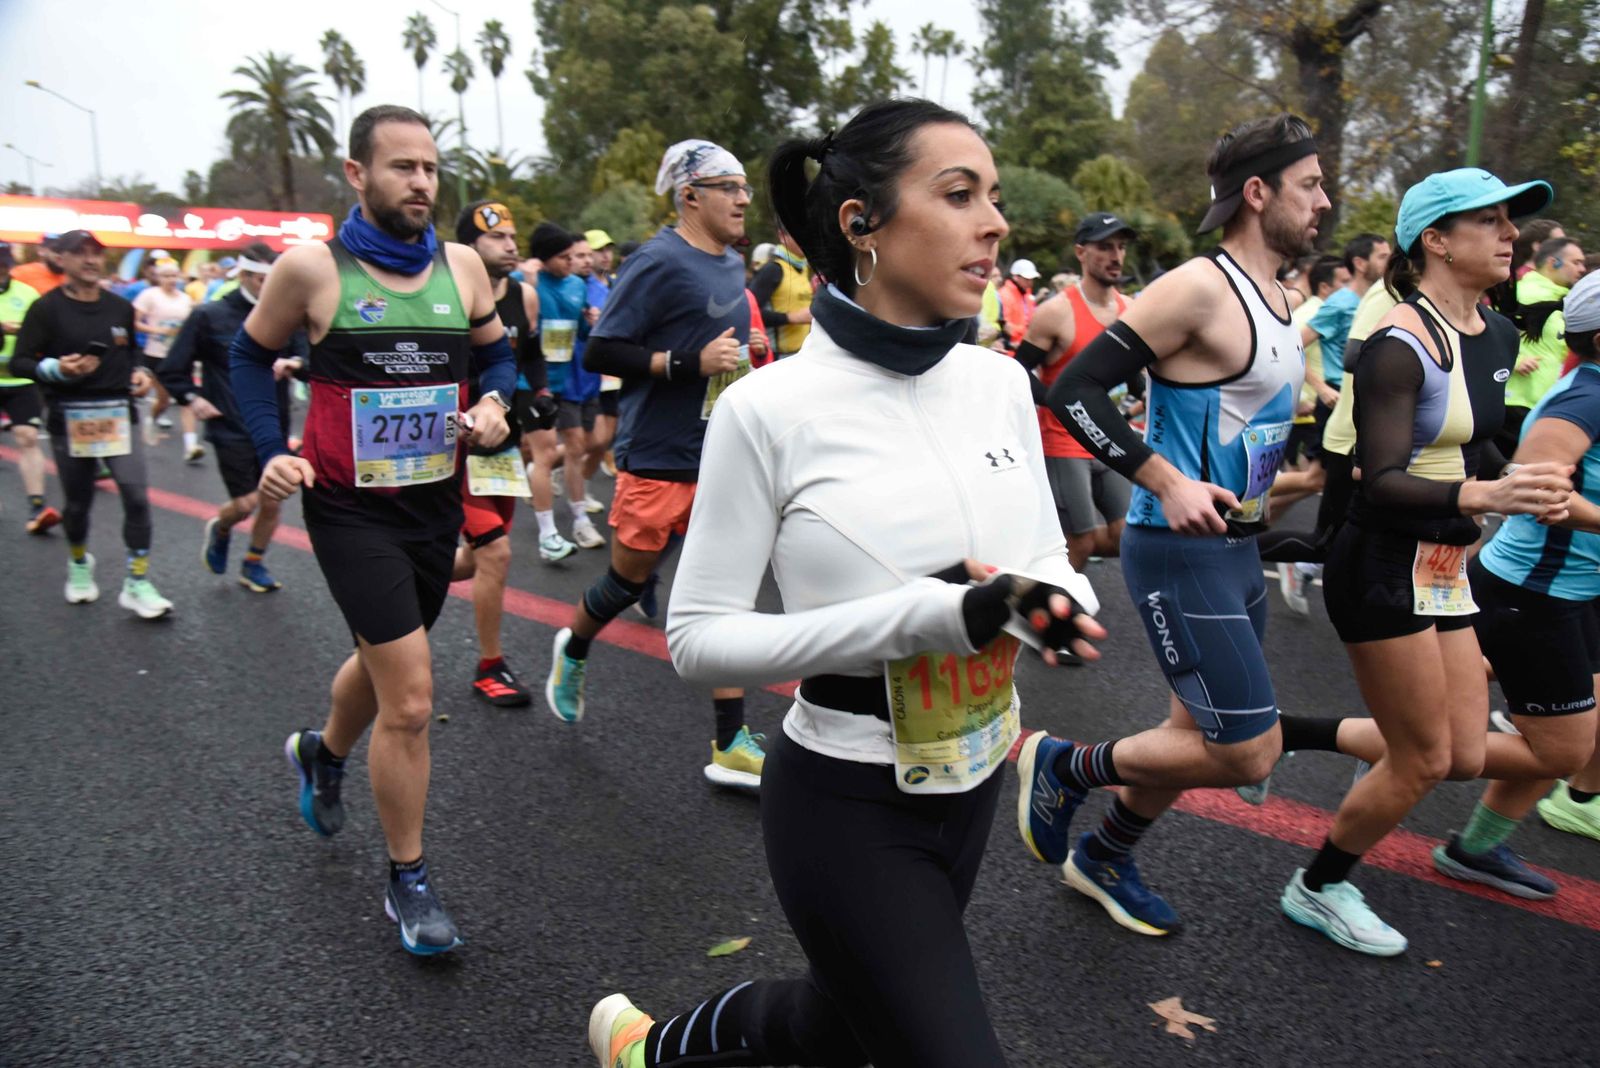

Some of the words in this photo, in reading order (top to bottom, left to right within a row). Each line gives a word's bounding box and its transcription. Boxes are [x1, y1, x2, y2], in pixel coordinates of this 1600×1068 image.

[372, 411, 438, 443] 2737
[1427, 544, 1463, 573] 427
[1148, 591, 1180, 666] WONG
